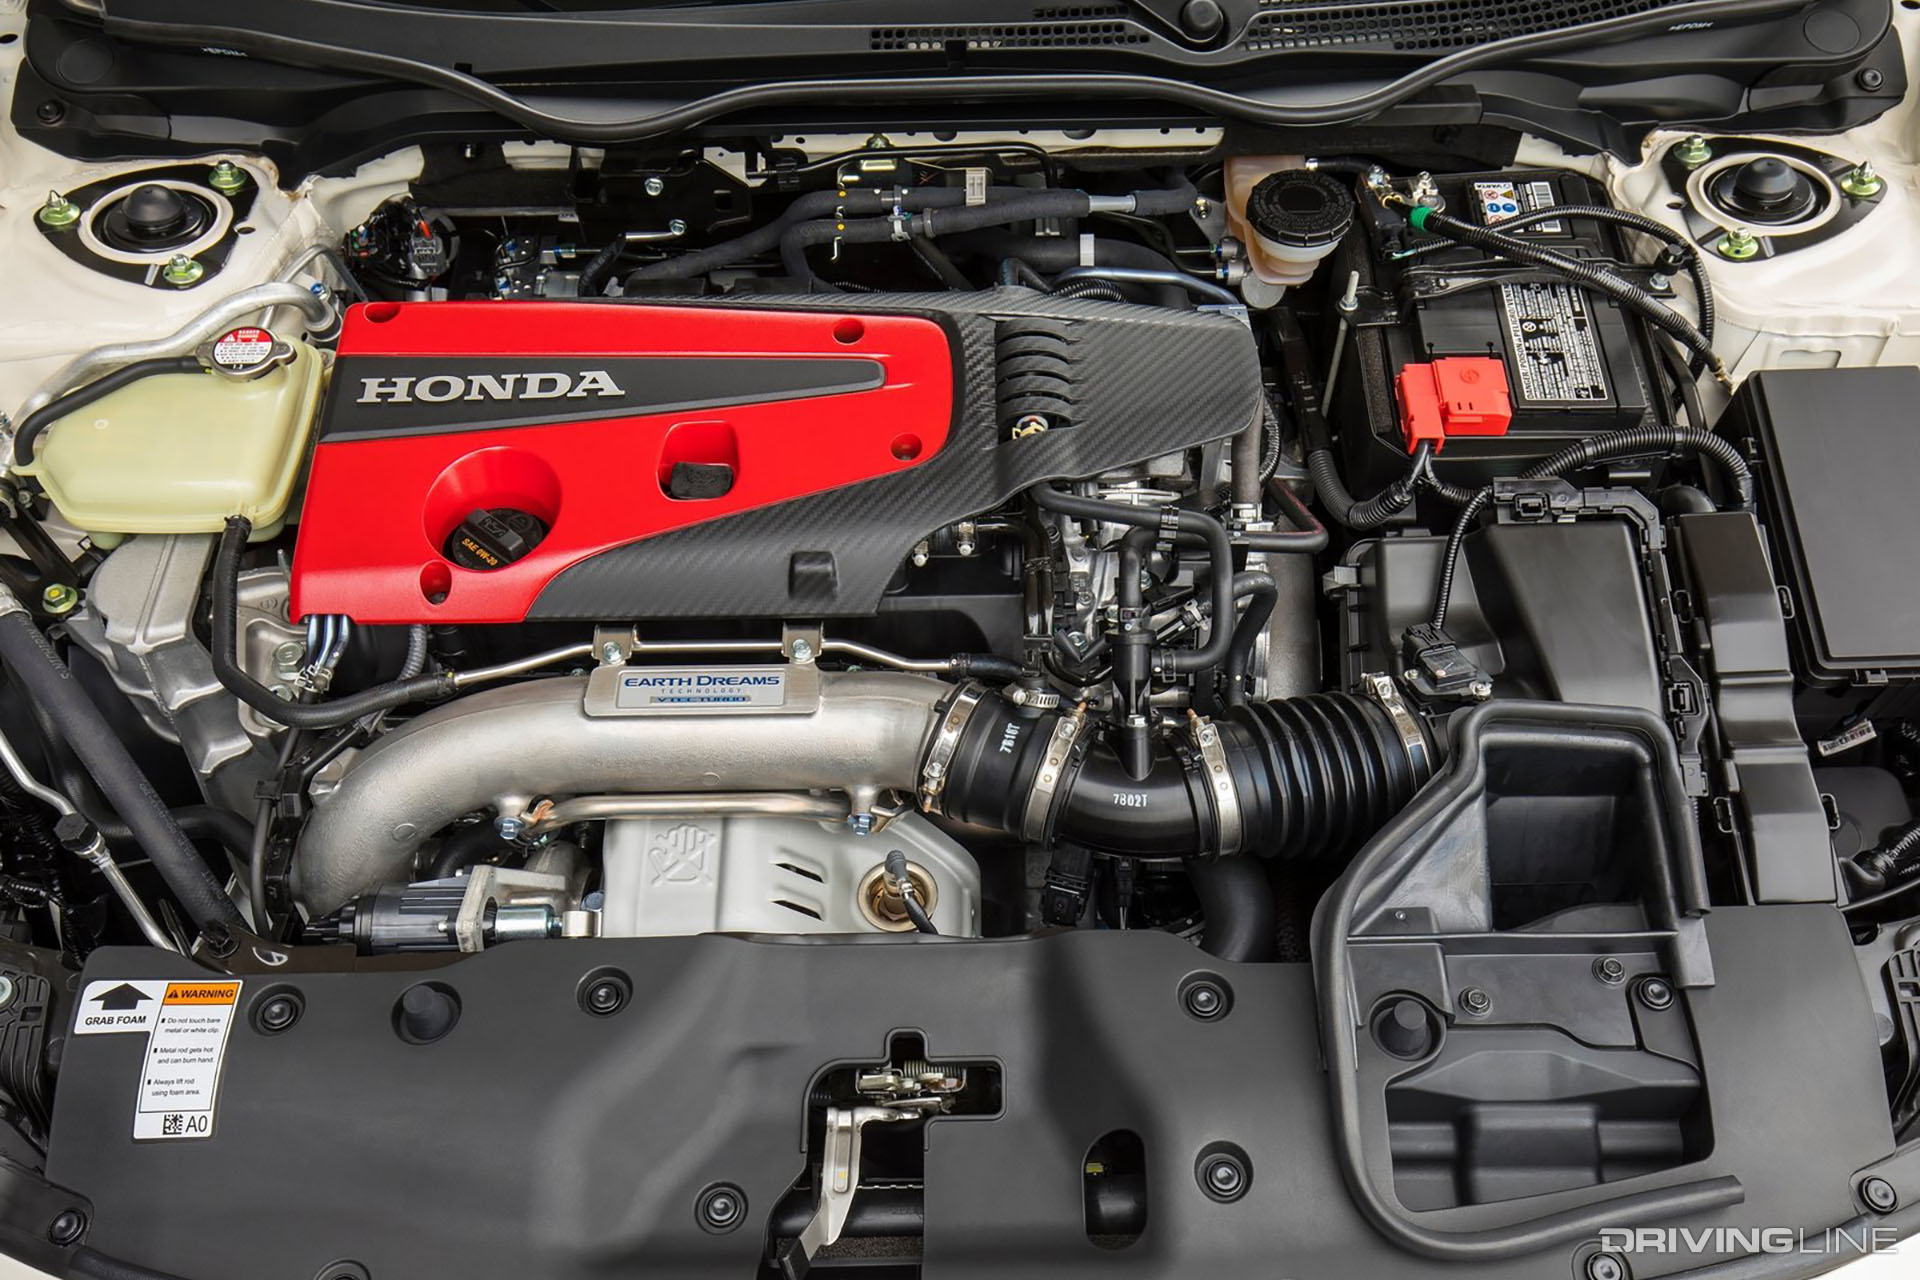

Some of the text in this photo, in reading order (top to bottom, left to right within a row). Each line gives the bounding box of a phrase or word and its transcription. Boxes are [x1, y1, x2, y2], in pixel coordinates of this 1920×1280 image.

[356, 370, 626, 403] HONDA
[461, 538, 479, 552] SAE
[624, 675, 780, 687] EARTH DREAMS
[181, 989, 234, 999] WARNING
[85, 1016, 147, 1026] GRAB FOAM
[185, 1115, 208, 1133] A0
